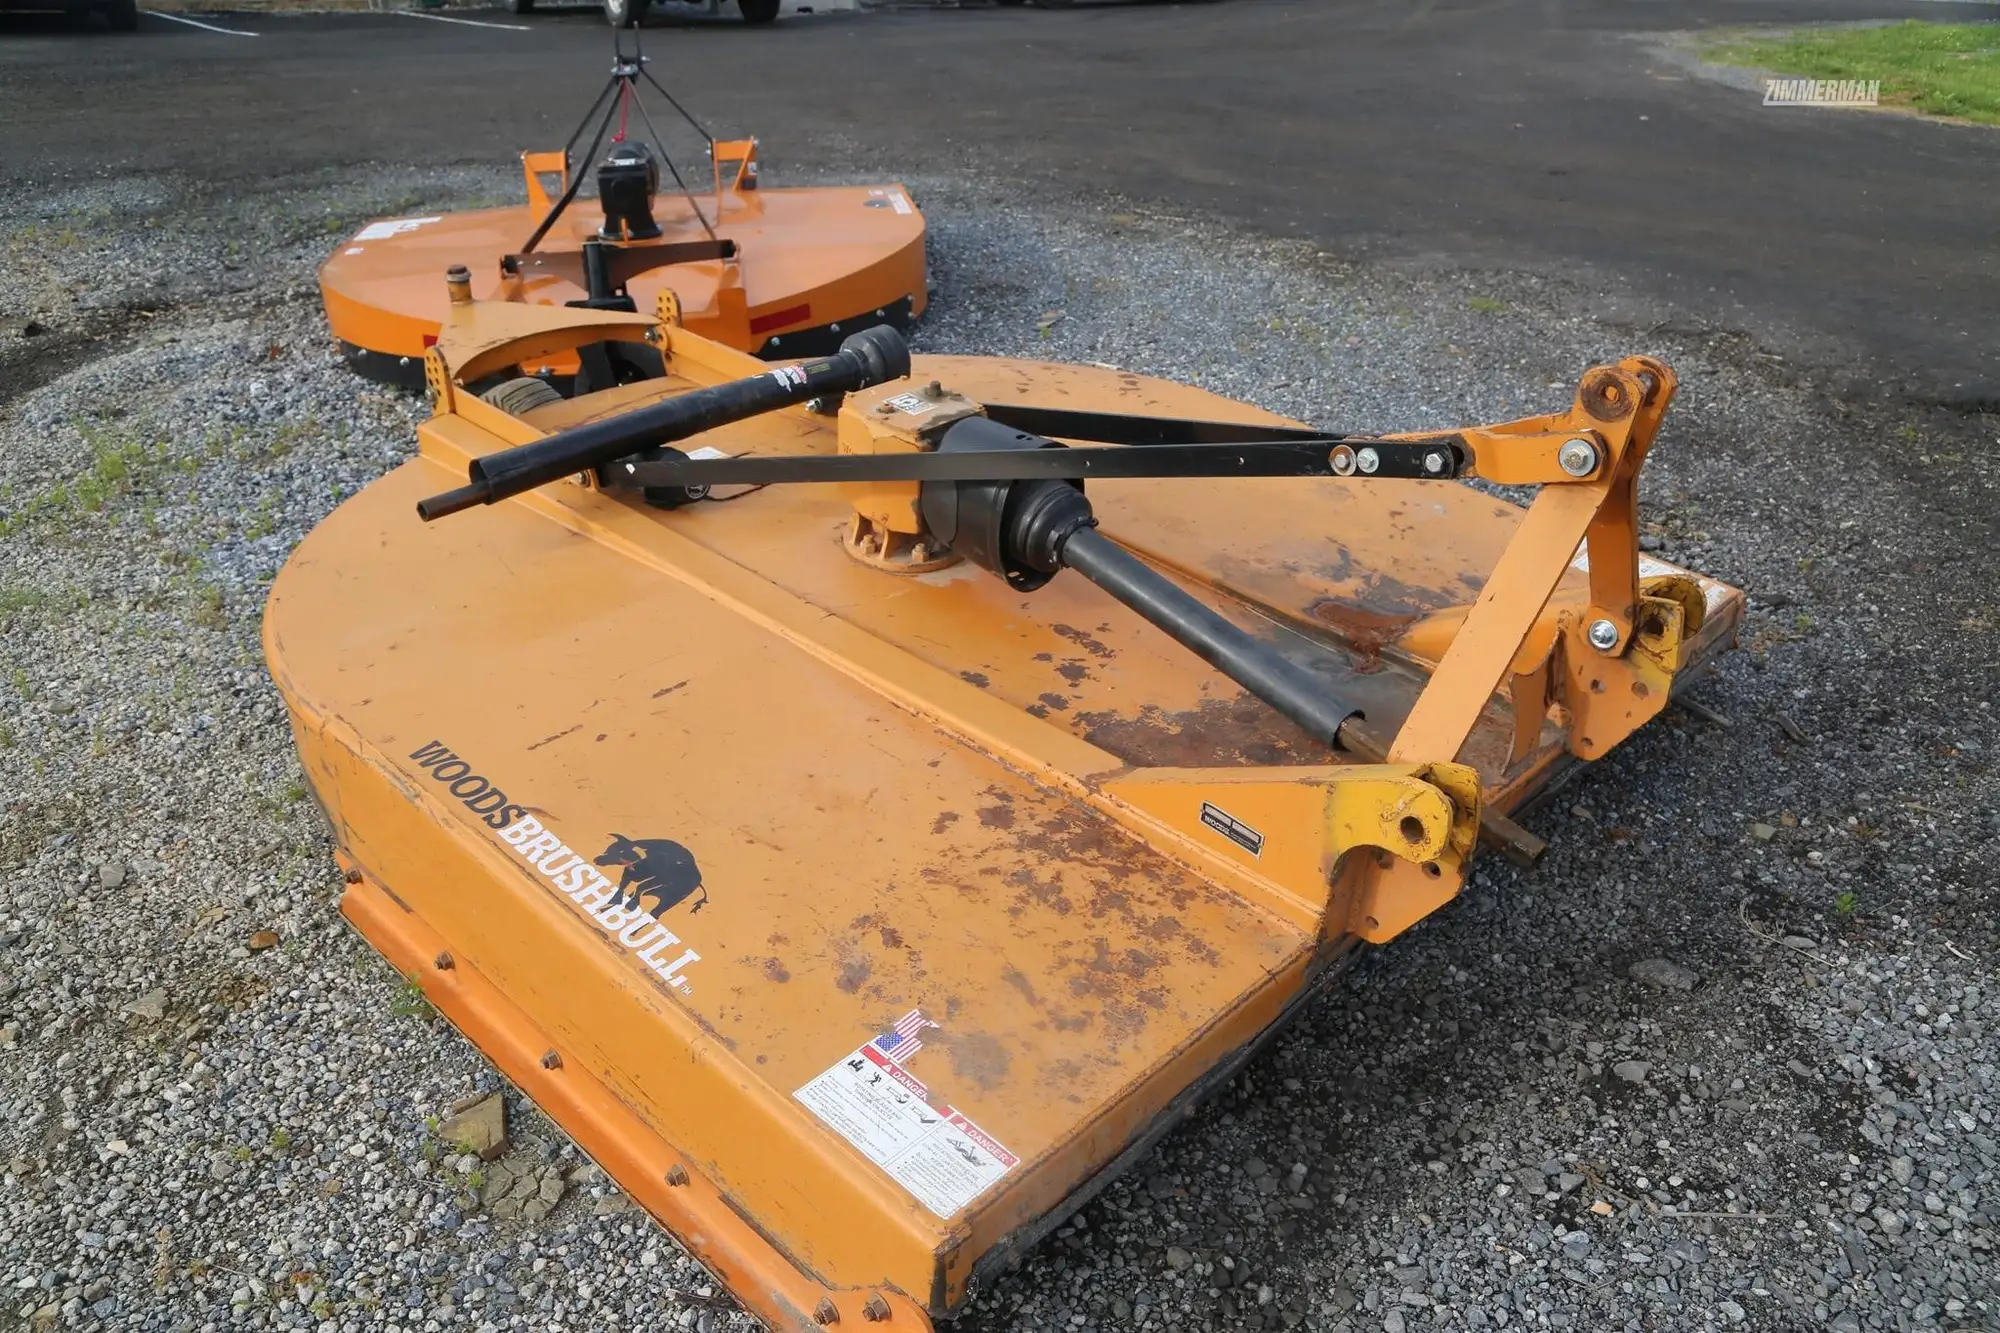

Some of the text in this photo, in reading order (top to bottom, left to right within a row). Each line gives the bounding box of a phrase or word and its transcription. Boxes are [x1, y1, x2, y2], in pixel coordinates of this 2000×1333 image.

[408, 739, 529, 830] WOODS
[496, 813, 702, 988] BRUSHBULL
[967, 1129, 1007, 1162] DANGER
